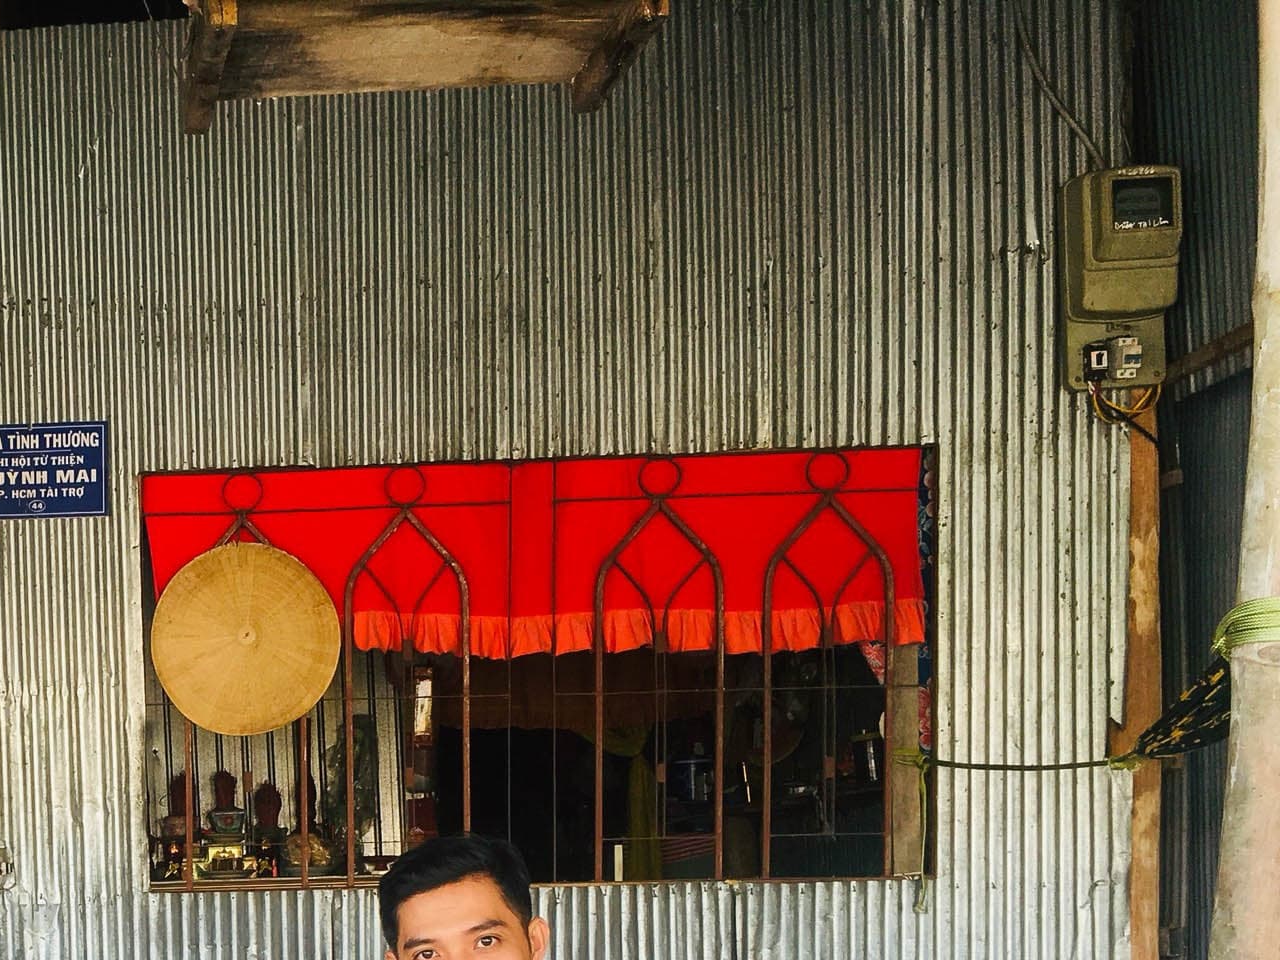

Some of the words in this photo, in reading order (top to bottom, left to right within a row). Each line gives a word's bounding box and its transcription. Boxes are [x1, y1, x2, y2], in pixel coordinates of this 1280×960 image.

[8, 431, 39, 449] TÌNH
[44, 430, 99, 448] THƯƠNG
[11, 455, 31, 468] HỘI
[33, 454, 49, 466] TỪ
[51, 453, 84, 466] THIỆN
[56, 468, 97, 483] MAI
[12, 489, 36, 499] HCM
[40, 486, 58, 498] TÀI
[61, 486, 84, 498] TRỢ
